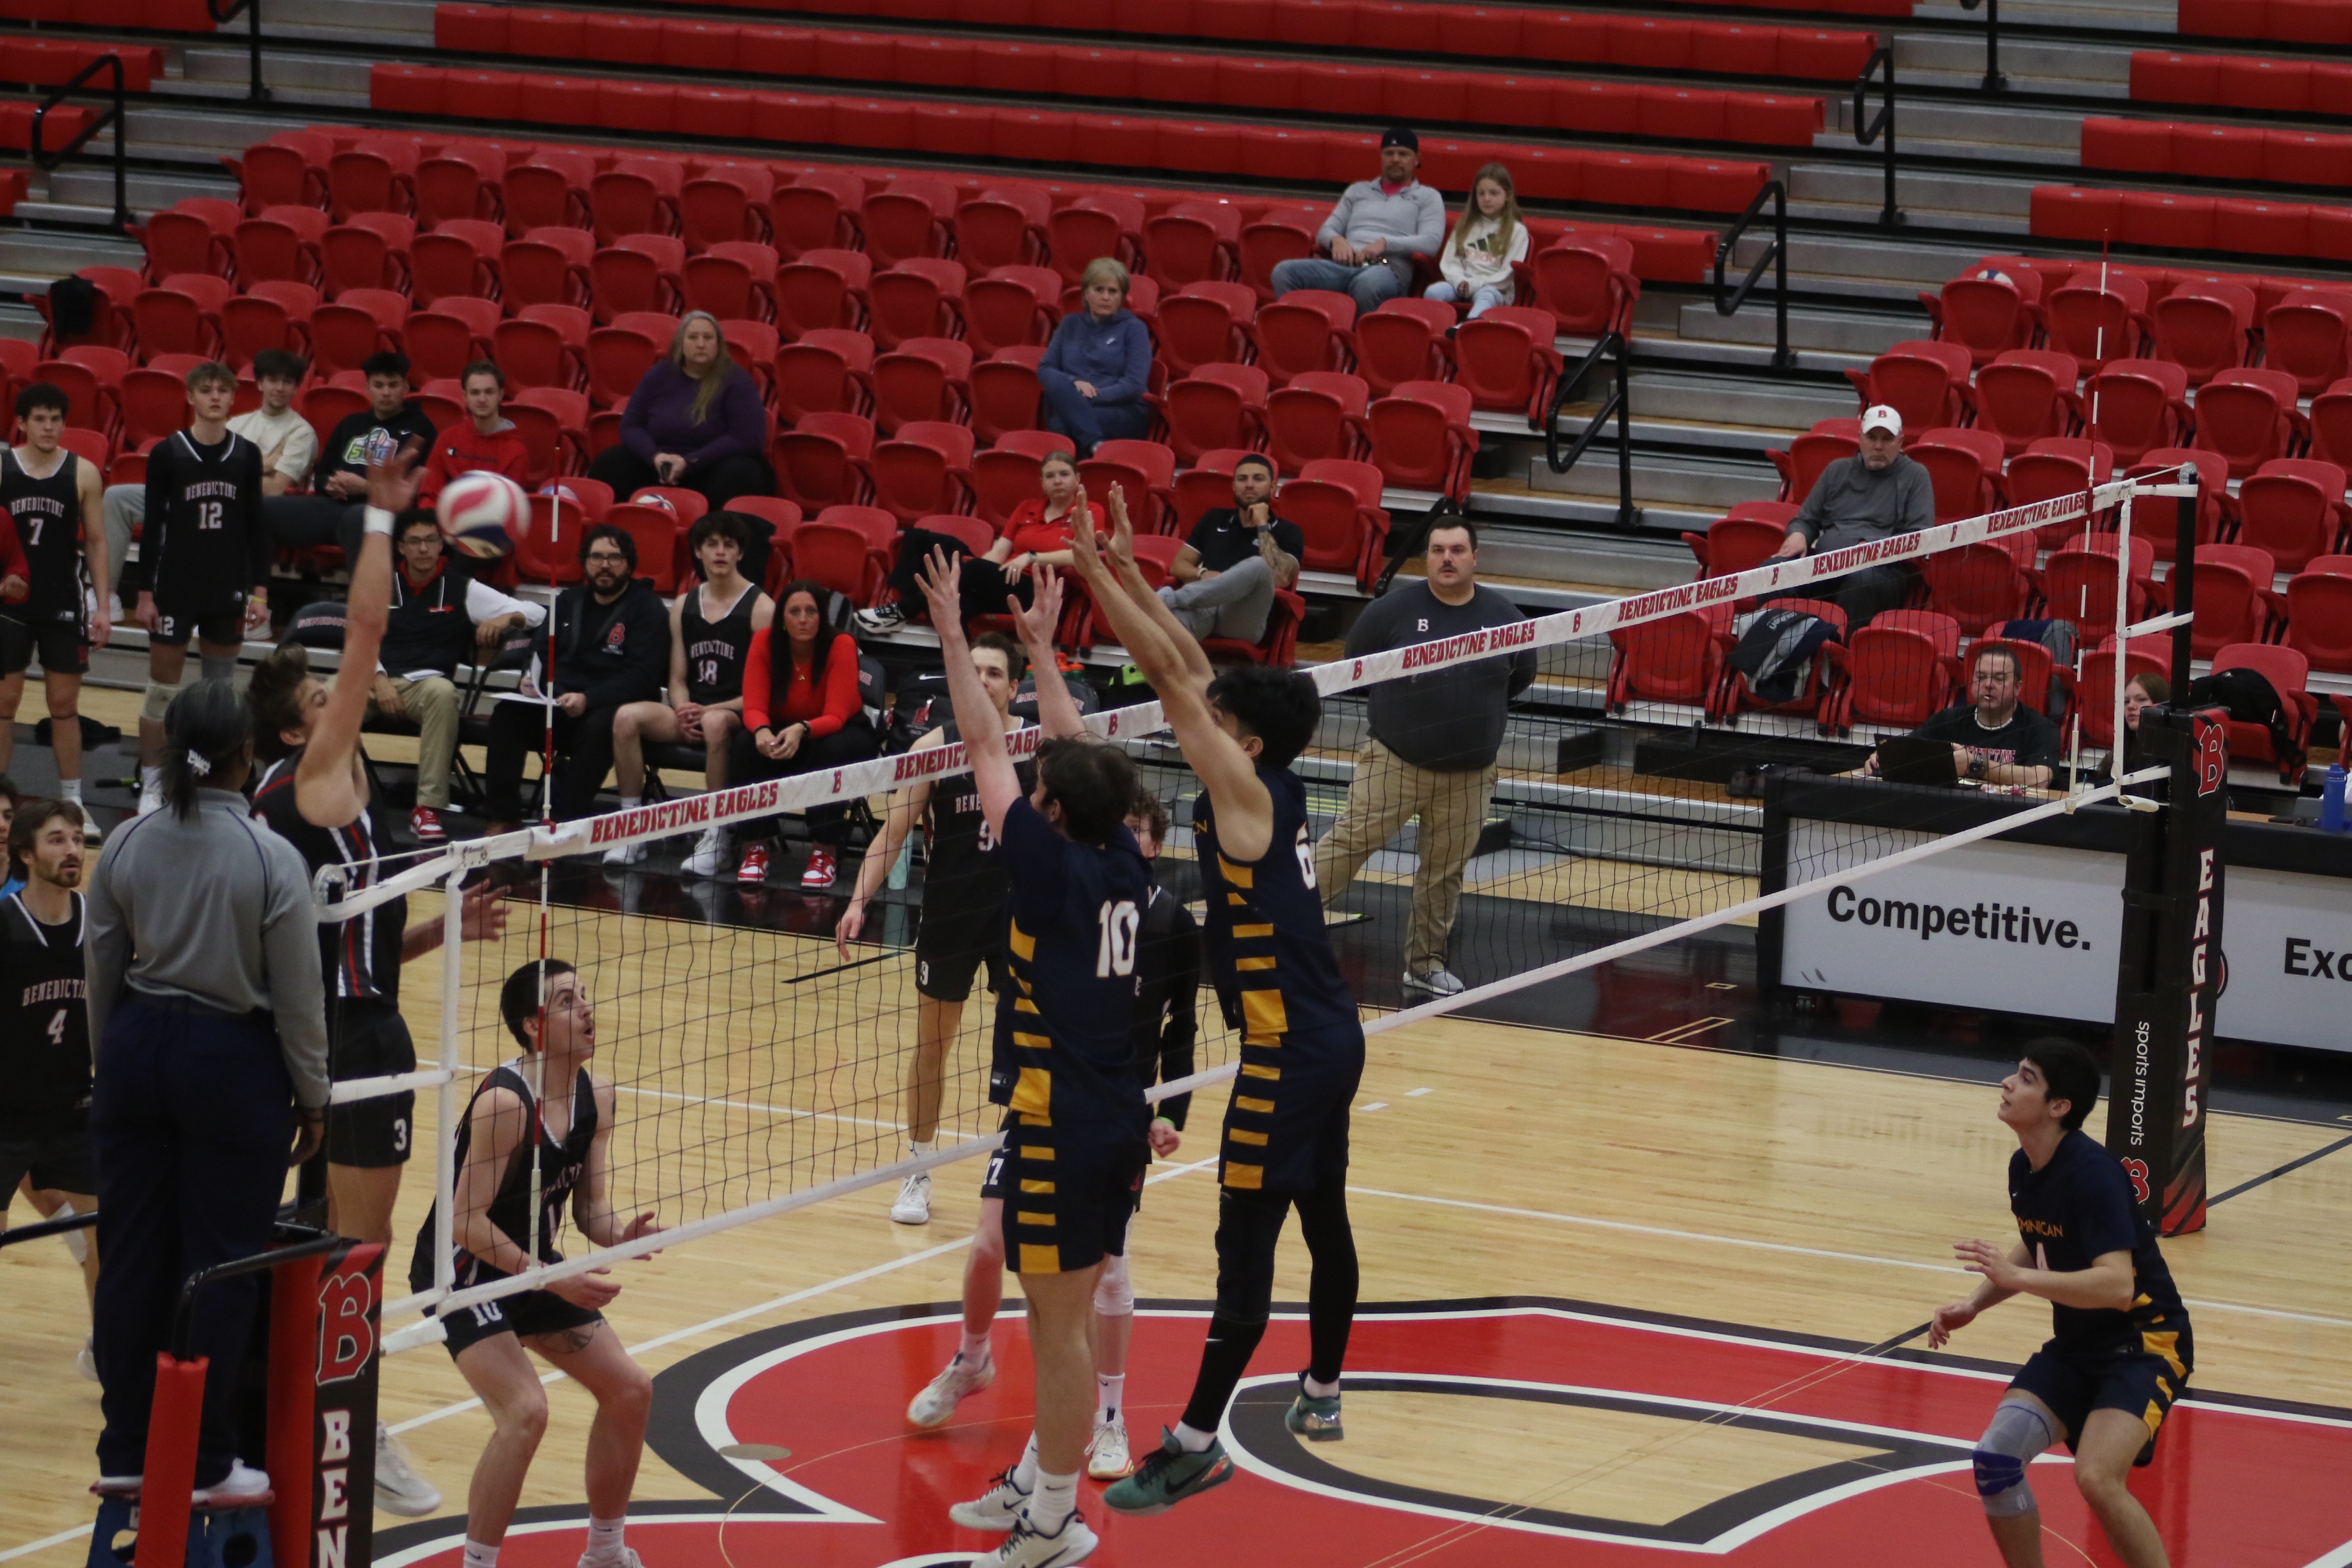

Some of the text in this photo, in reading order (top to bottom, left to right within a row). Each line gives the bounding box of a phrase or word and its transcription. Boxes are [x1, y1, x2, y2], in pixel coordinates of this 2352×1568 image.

[11, 496, 64, 518] BENEDICTINE
[185, 481, 237, 502] BENEDICTINE
[29, 518, 44, 545] 7
[199, 502, 223, 529] 12
[1986, 494, 2085, 534] BENEDICTINE EAGLES
[1950, 524, 1958, 543] B
[1811, 533, 1921, 577] BENEDICTINE EAGLES
[1770, 566, 1779, 586] B
[1617, 576, 1738, 623] BENEDICTINE EAGLES
[607, 622, 625, 645] B
[1417, 618, 1429, 632] B
[1573, 612, 1581, 633] B
[1402, 622, 1536, 670] BENEDICTINE EAGLES
[1352, 660, 1362, 681] B
[1108, 713, 1118, 736] B
[2198, 723, 2224, 798] B
[832, 770, 848, 794] B
[591, 782, 778, 844] BENEDICTINE EAGLES
[1827, 885, 2091, 951] Competitive.
[1096, 899, 1140, 978] 10
[2182, 847, 2214, 1130] EAGLES
[46, 1008, 68, 1045] 4
[2130, 1021, 2150, 1146] sports imports
[394, 1118, 407, 1152] 3
[2120, 1156, 2150, 1205] B
[315, 1272, 374, 1387] B
[469, 1300, 503, 1327] 10
[316, 1407, 352, 1568] BEN
